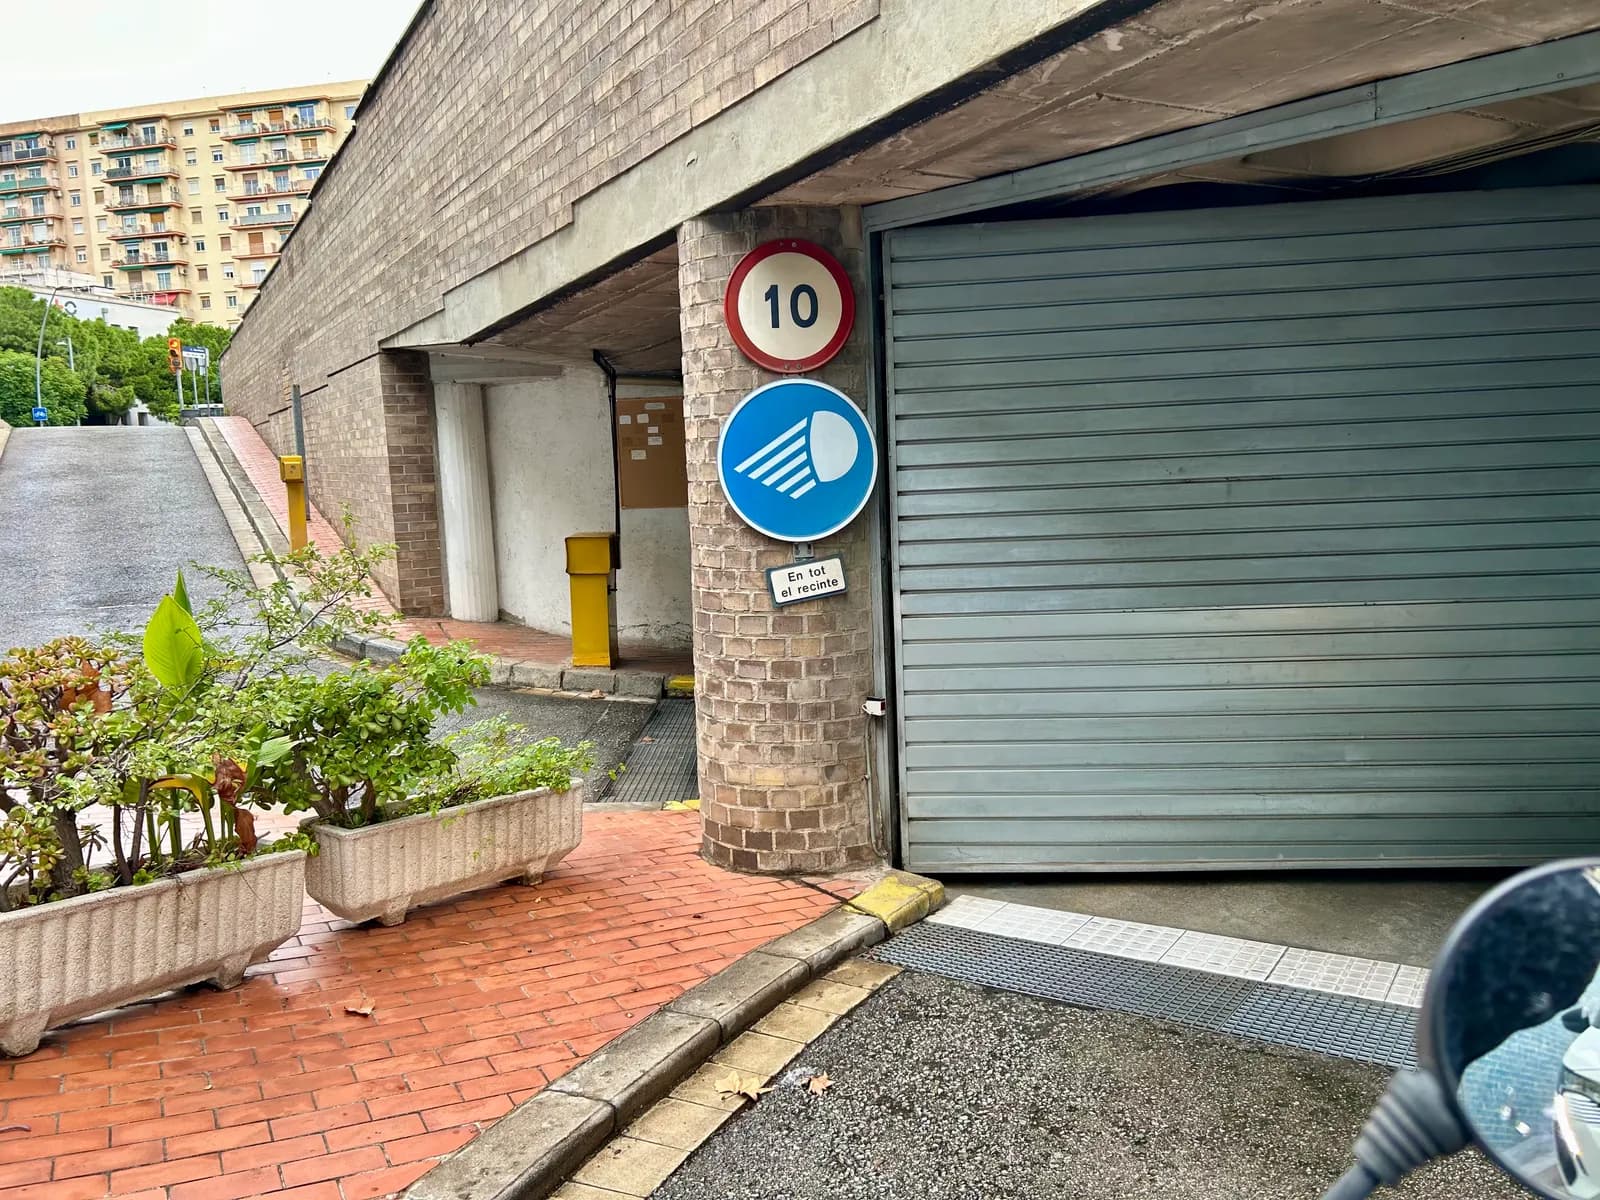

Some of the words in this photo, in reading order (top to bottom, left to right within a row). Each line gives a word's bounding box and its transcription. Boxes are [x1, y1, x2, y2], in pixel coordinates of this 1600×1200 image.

[764, 284, 818, 328] 10
[787, 571, 803, 582] En
[808, 566, 826, 578] tot
[781, 587, 792, 597] el
[797, 578, 839, 594] recinte
